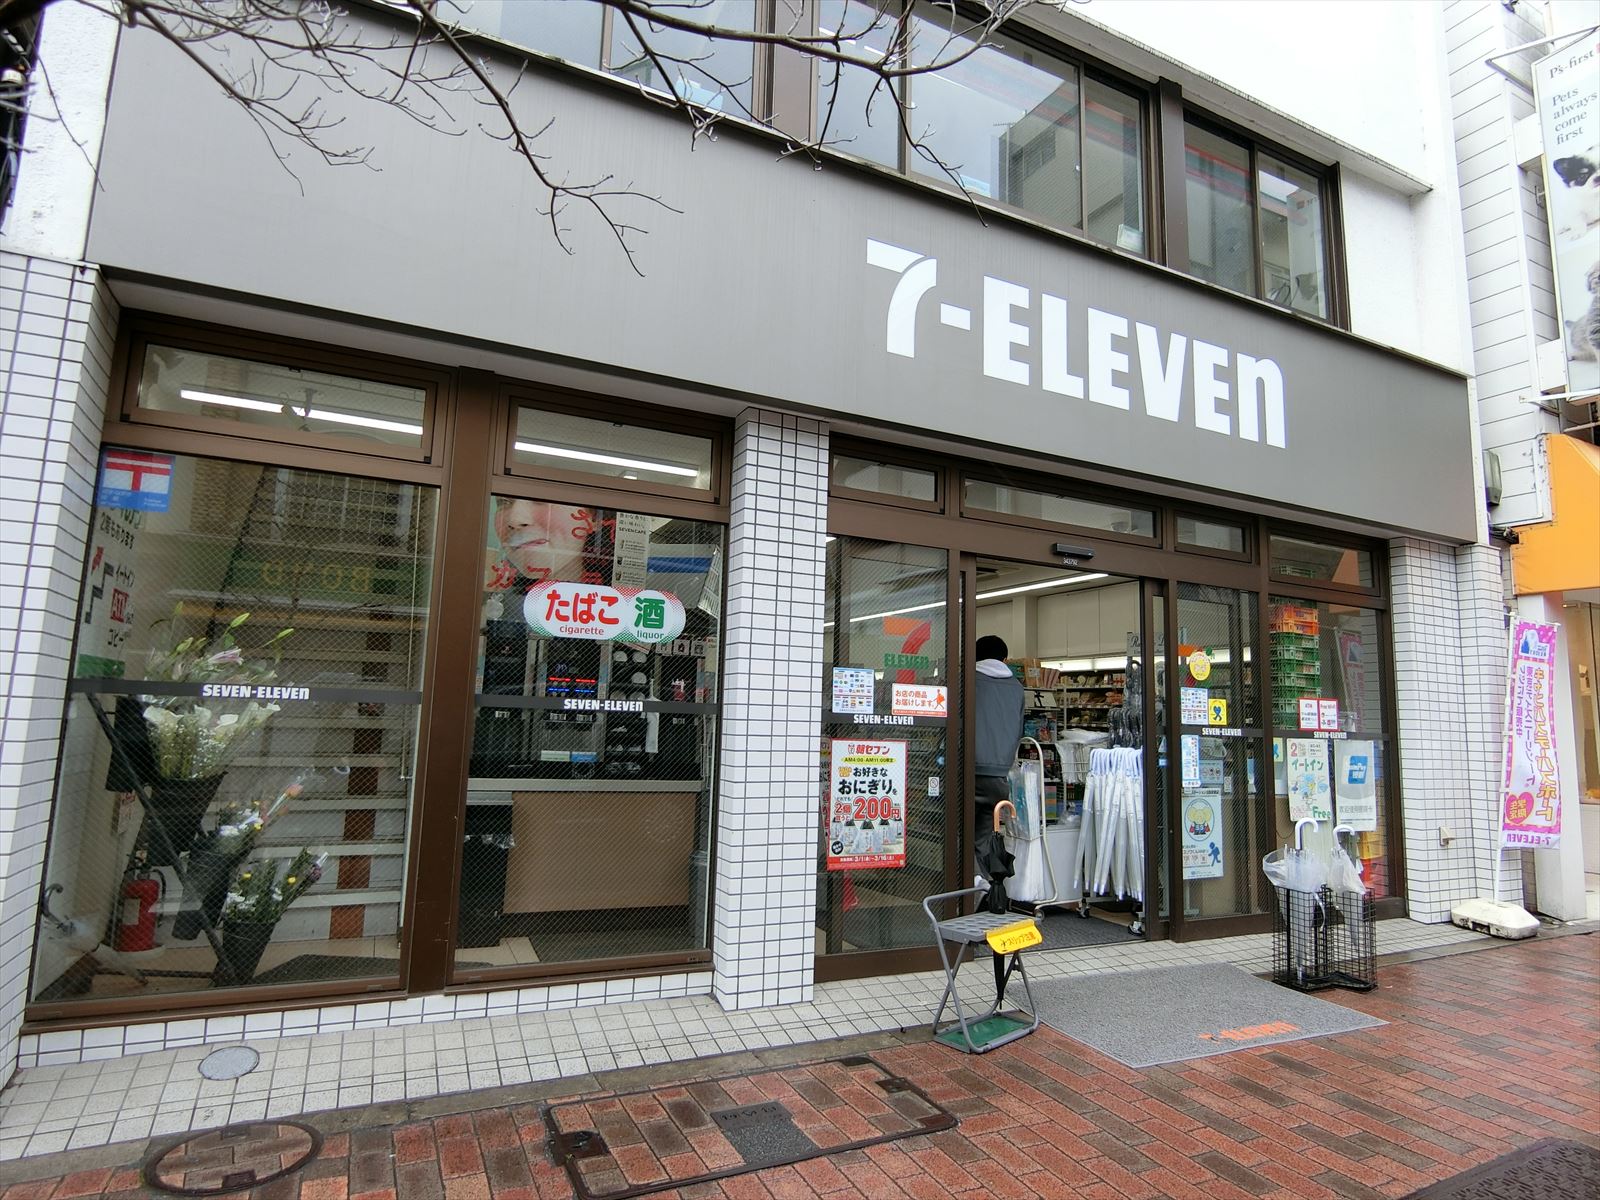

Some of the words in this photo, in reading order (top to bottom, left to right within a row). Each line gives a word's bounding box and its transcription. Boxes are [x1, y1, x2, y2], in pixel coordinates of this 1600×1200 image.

[1552, 88, 1579, 107] Pets
[1553, 91, 1598, 120] always
[1555, 111, 1588, 132] come
[1556, 126, 1584, 146] first
[545, 589, 620, 626] たばこ
[634, 596, 666, 629] 酒
[559, 624, 605, 636] cigarette
[636, 630, 664, 641] liquor
[1290, 742, 1298, 757] 2
[852, 767, 888, 777] お好きな
[1291, 759, 1324, 771] イートイン
[1312, 805, 1331, 819] Free
